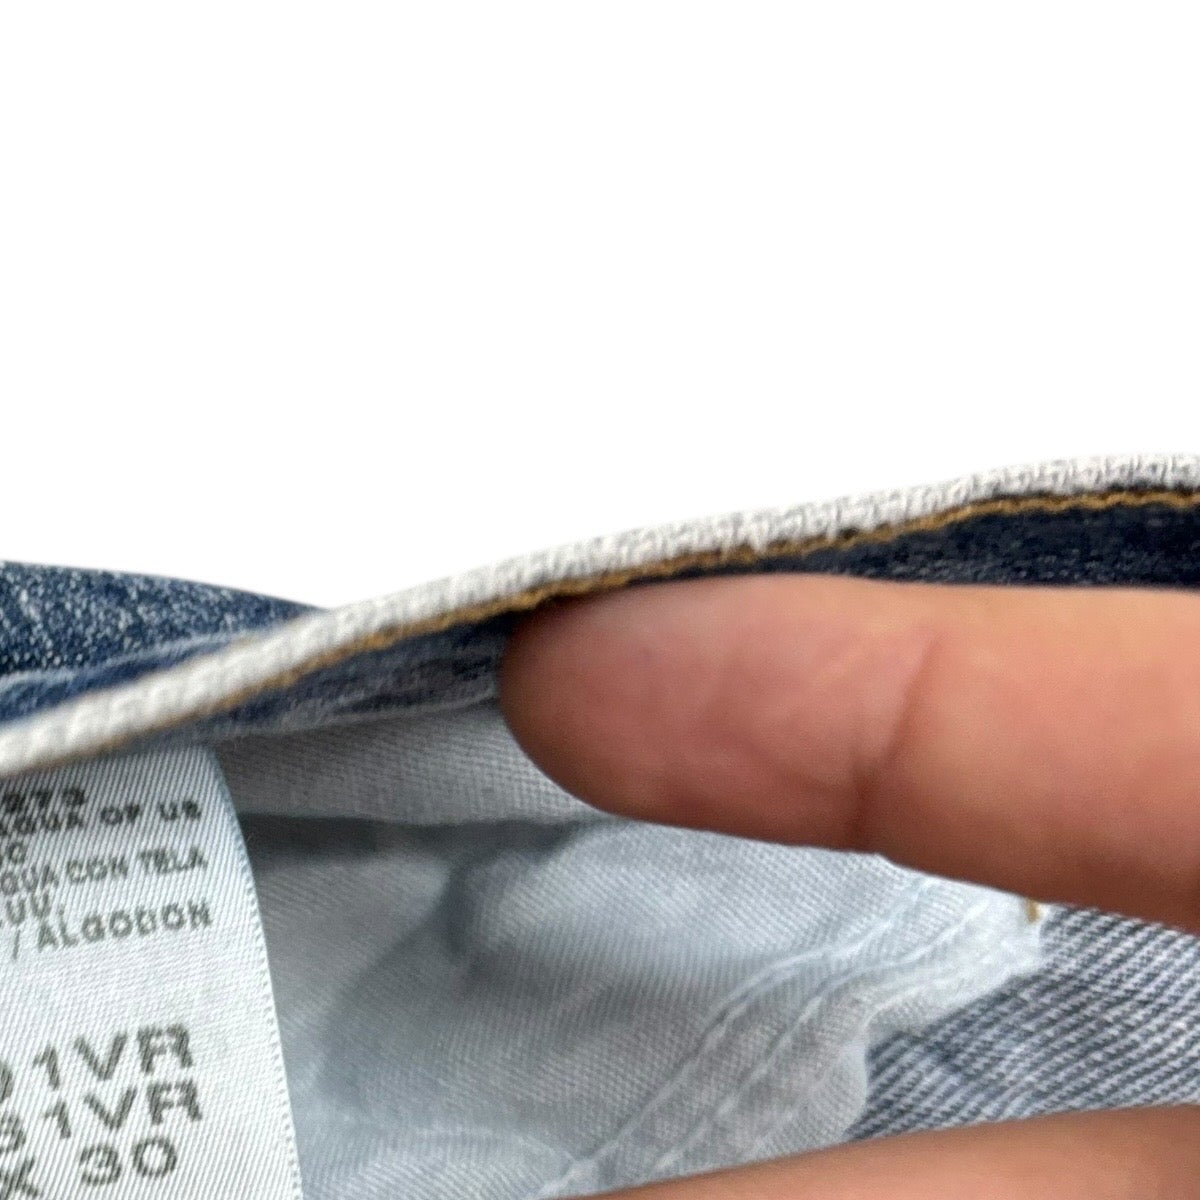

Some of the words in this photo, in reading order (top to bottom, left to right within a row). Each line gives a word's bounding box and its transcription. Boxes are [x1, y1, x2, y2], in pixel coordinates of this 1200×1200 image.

[157, 800, 201, 822] US
[65, 854, 130, 885] CON
[135, 846, 209, 877] TELA
[11, 928, 22, 960] /
[36, 899, 214, 952] ALGODON
[79, 1136, 179, 1189] 30
